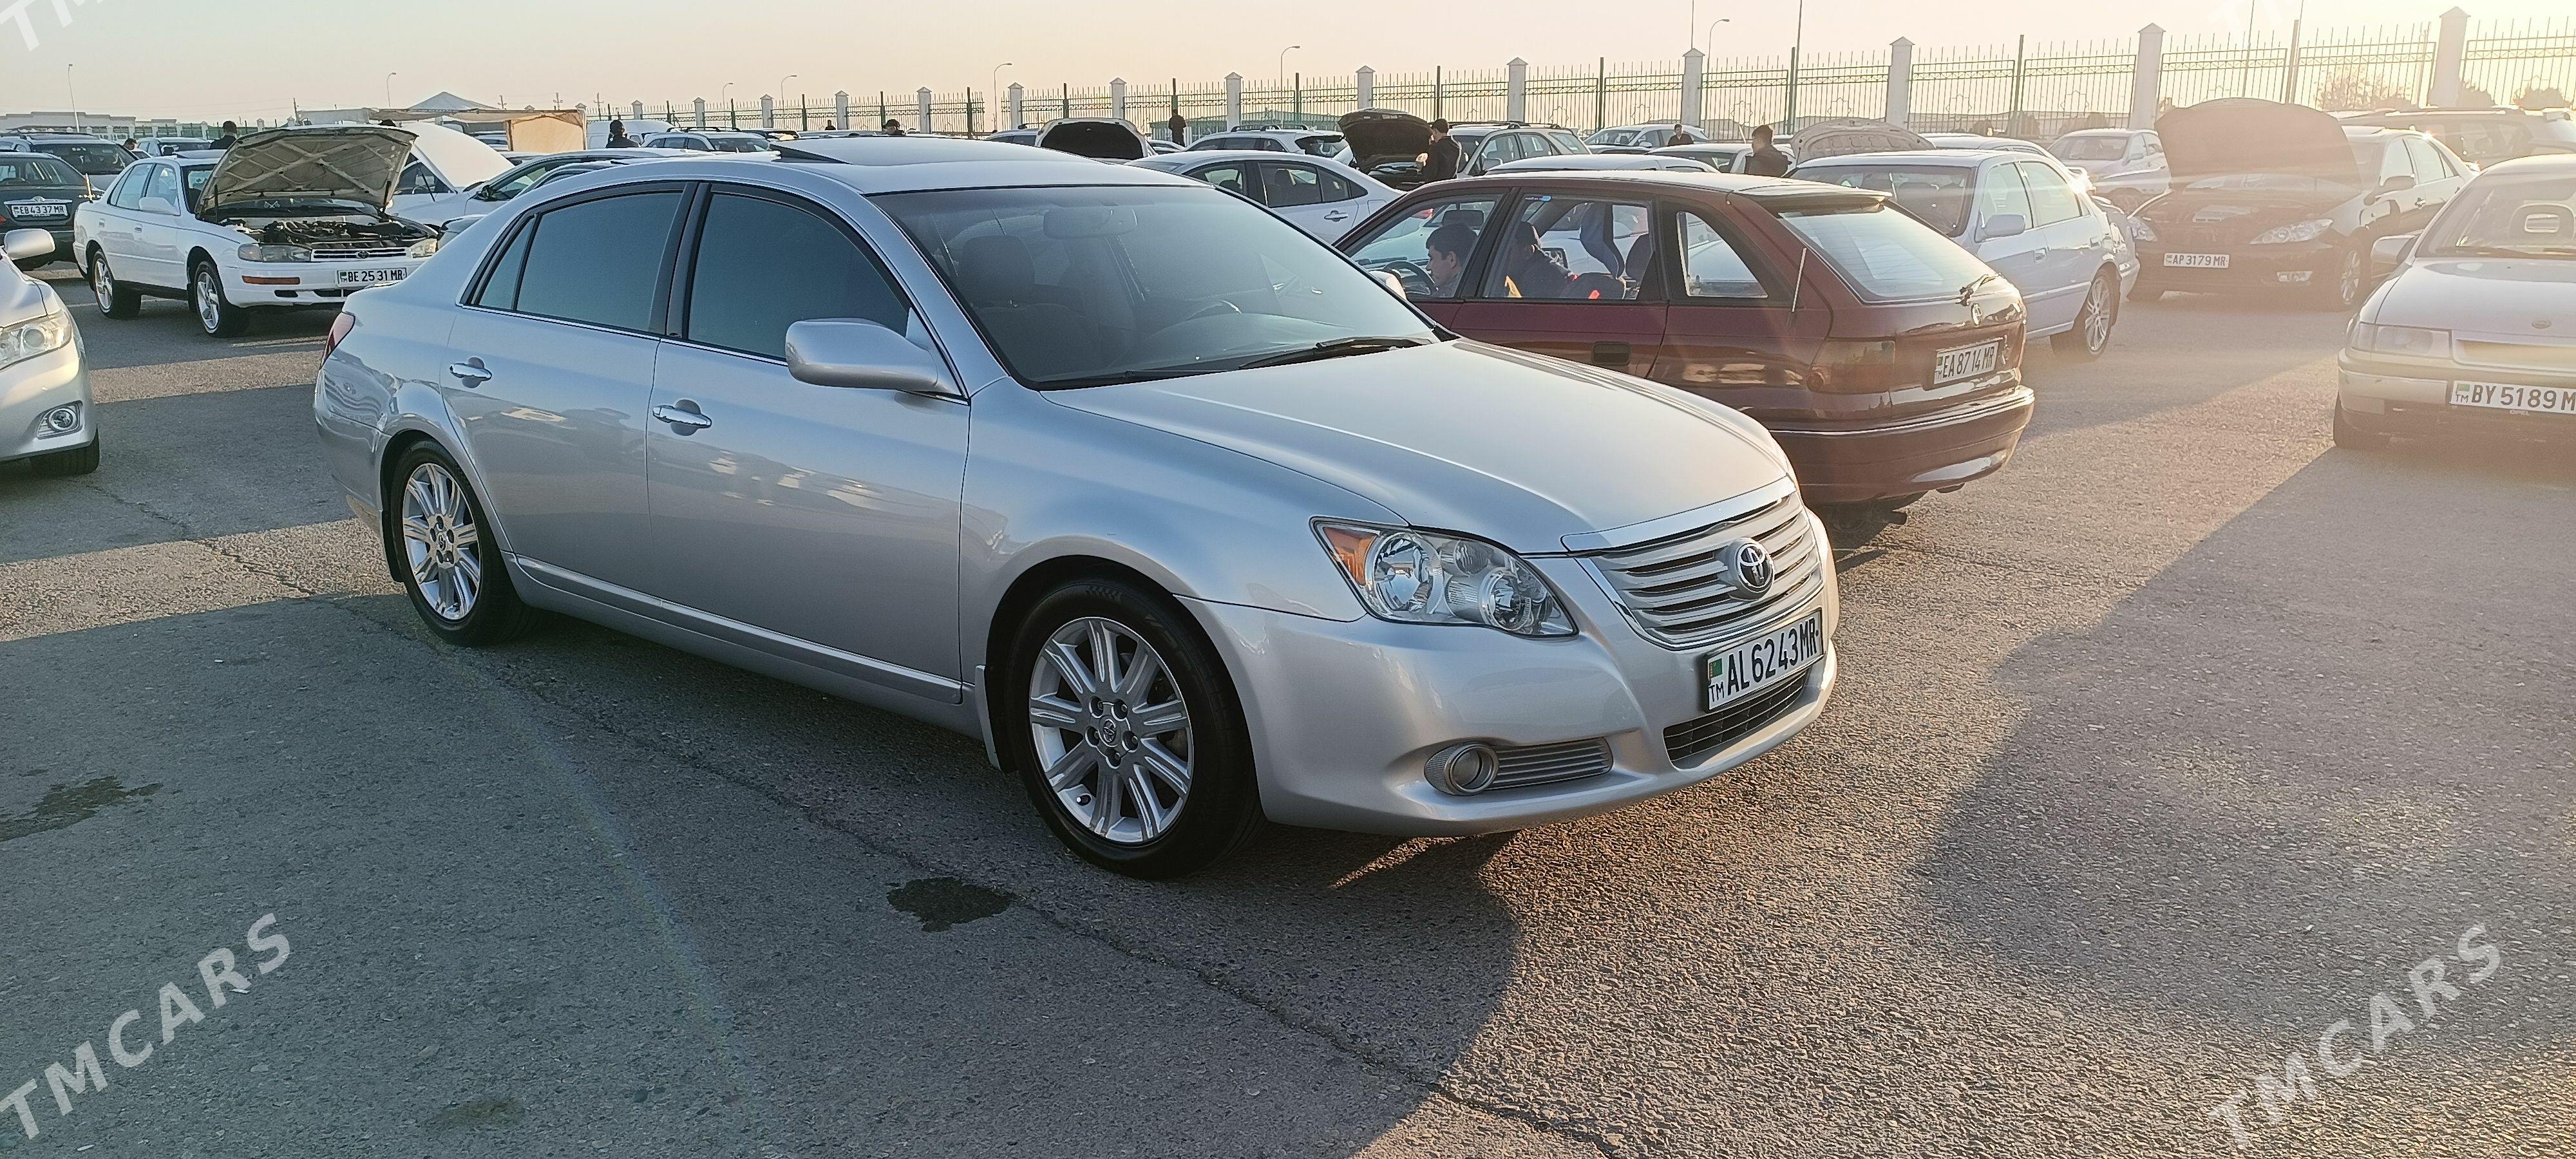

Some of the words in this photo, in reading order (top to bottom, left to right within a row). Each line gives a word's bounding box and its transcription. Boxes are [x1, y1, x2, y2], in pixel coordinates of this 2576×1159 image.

[2173, 254, 2184, 265] AP
[2213, 256, 2226, 266] MR
[390, 270, 403, 280] MR
[1942, 354, 1955, 378] EA
[1982, 346, 1995, 370] MR
[2455, 393, 2469, 404] TM
[2471, 384, 2497, 404] BY
[1709, 681, 1725, 702] TM
